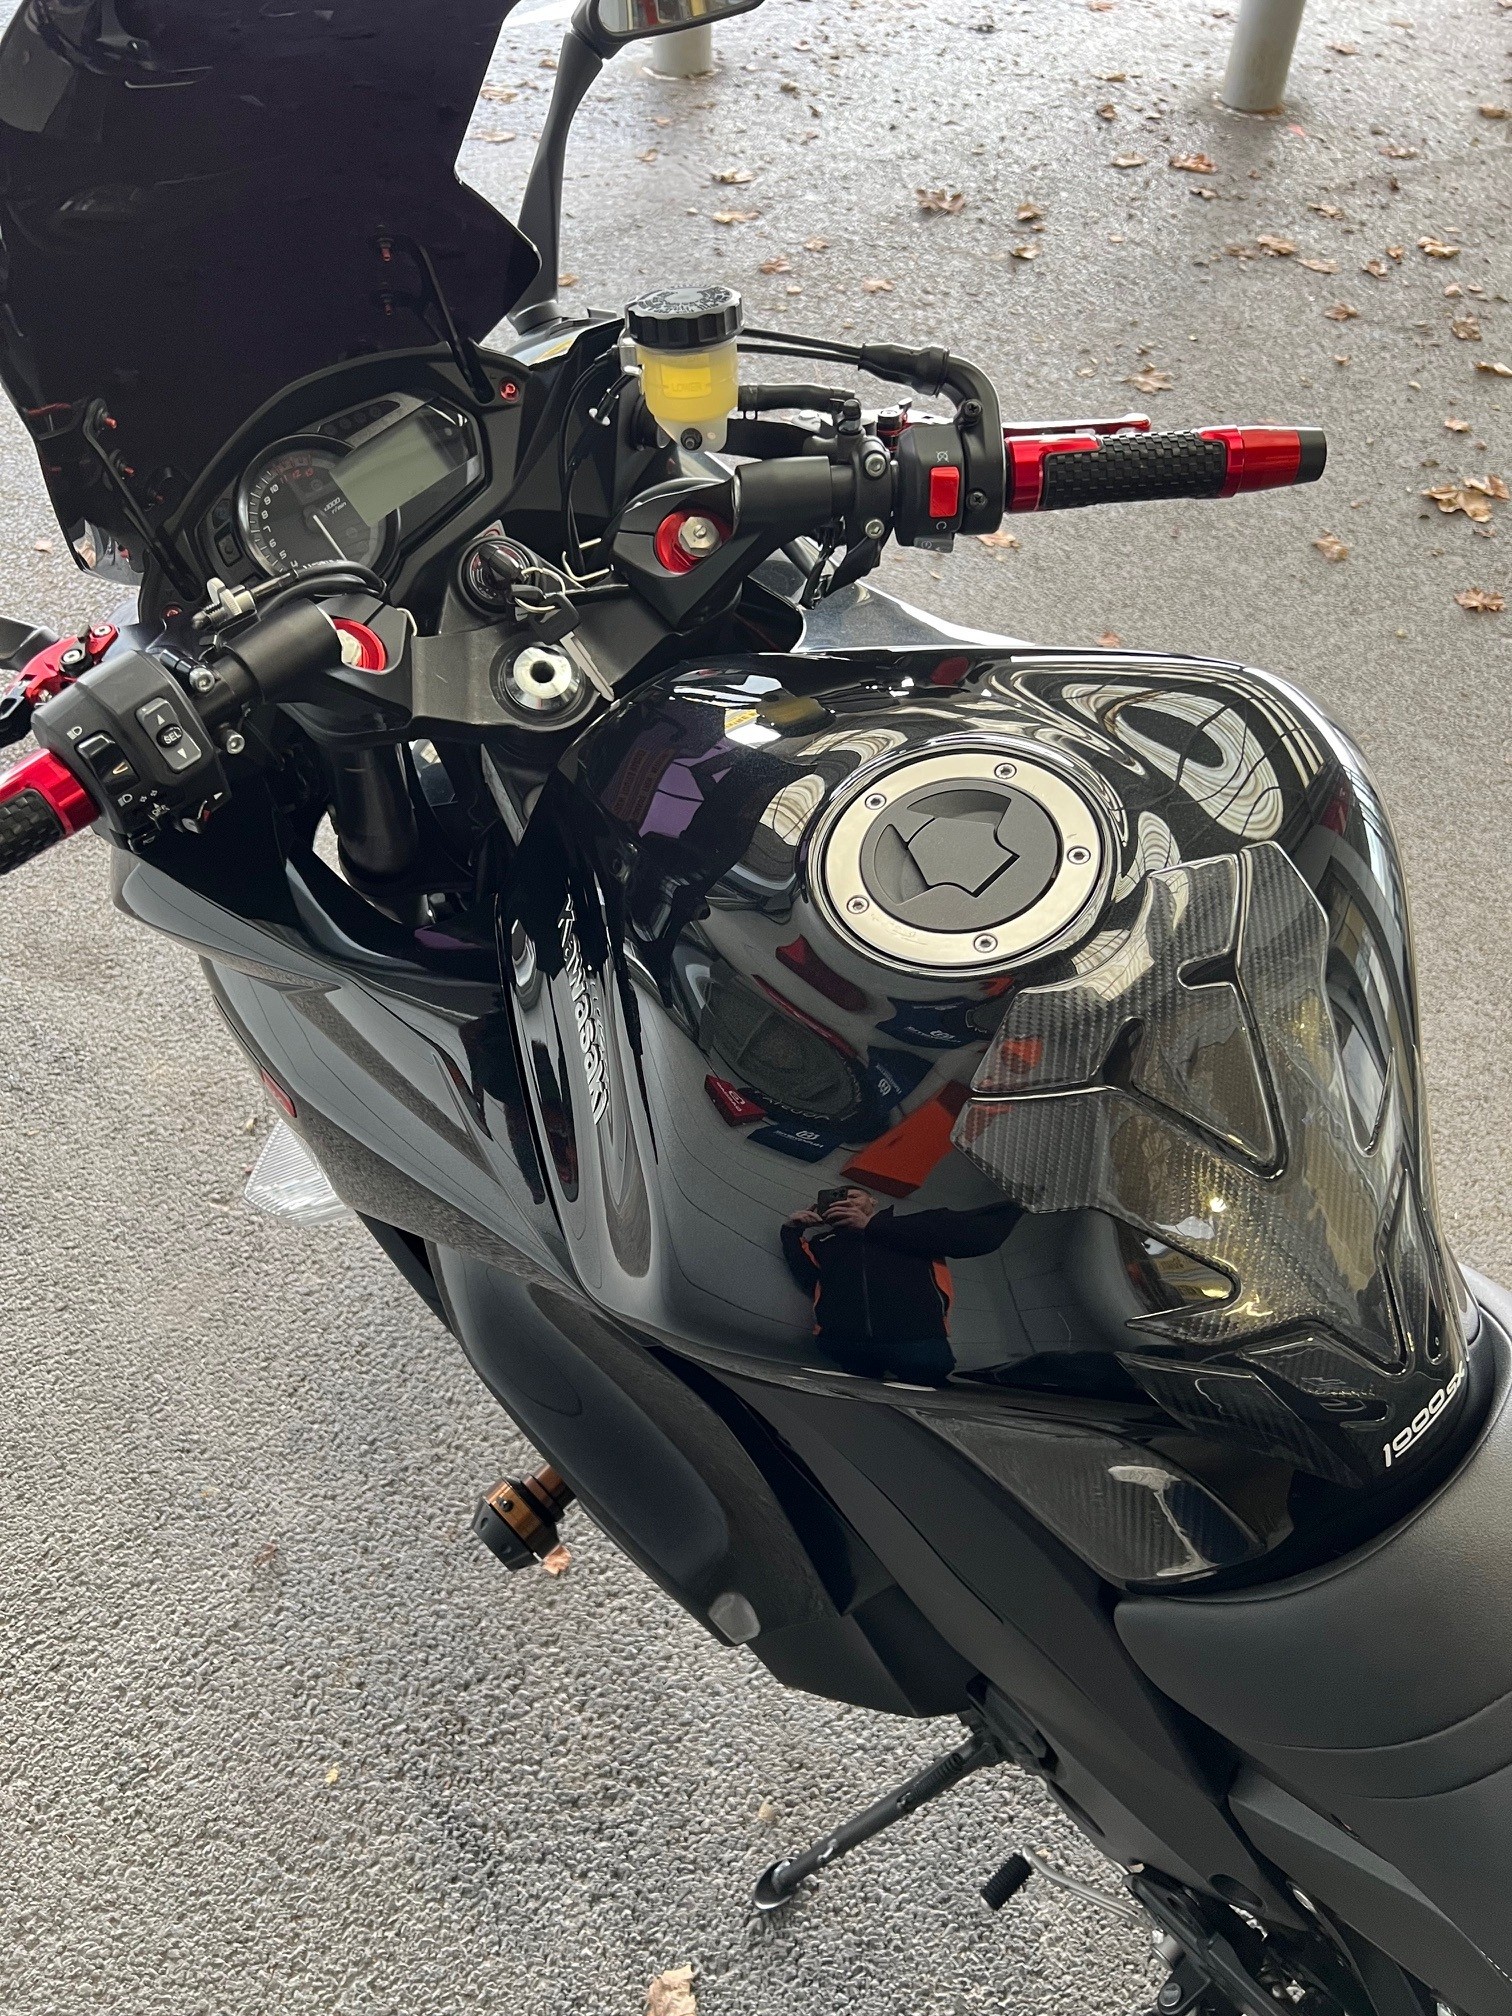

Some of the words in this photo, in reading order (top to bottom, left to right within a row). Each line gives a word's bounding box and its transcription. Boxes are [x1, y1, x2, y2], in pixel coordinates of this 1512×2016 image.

[270, 484, 279, 493] 10
[264, 497, 271, 505] 9
[261, 510, 269, 519] 8
[269, 538, 276, 548] 6
[279, 550, 287, 559] 5
[163, 730, 182, 744] SEL
